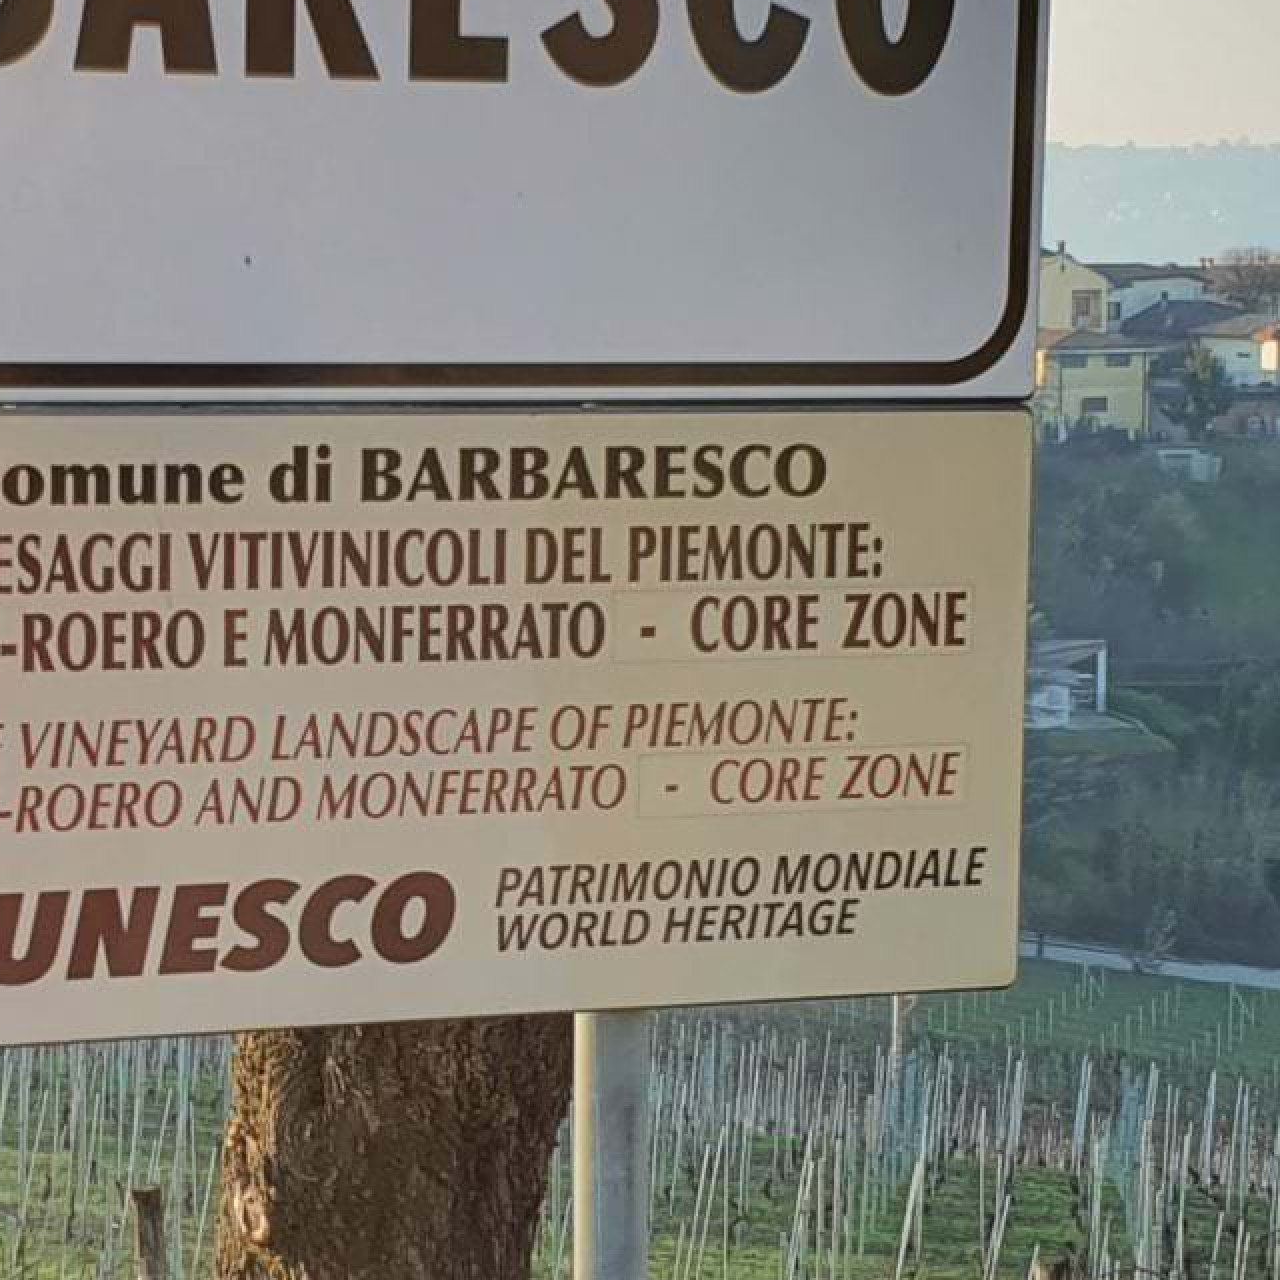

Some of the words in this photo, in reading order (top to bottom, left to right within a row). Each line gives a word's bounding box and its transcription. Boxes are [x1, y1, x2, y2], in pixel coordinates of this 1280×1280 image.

[268, 444, 332, 505] di
[360, 442, 827, 503] BARBARESCO
[186, 527, 508, 591] VITIVINICOLI
[524, 525, 613, 585] DEL
[628, 521, 884, 583] PIEMONTE:
[224, 608, 249, 669] E
[264, 600, 607, 667] MONFERRATO
[690, 593, 821, 654] CORE
[841, 591, 968, 649] ZONE
[19, 716, 257, 771] VINEYARD
[269, 707, 539, 761] LANDSCAPE
[549, 703, 615, 753] OF
[621, 697, 860, 750] PIEMONTE:
[193, 775, 303, 827] AND
[315, 763, 627, 821] MONFERRATO
[709, 756, 829, 805] CORE
[837, 751, 961, 801] ZONE
[495, 856, 761, 909] PATRIMONIO
[771, 845, 989, 897] MONDIALE
[497, 907, 651, 953] WORLD
[661, 897, 861, 945] HERITAGE
